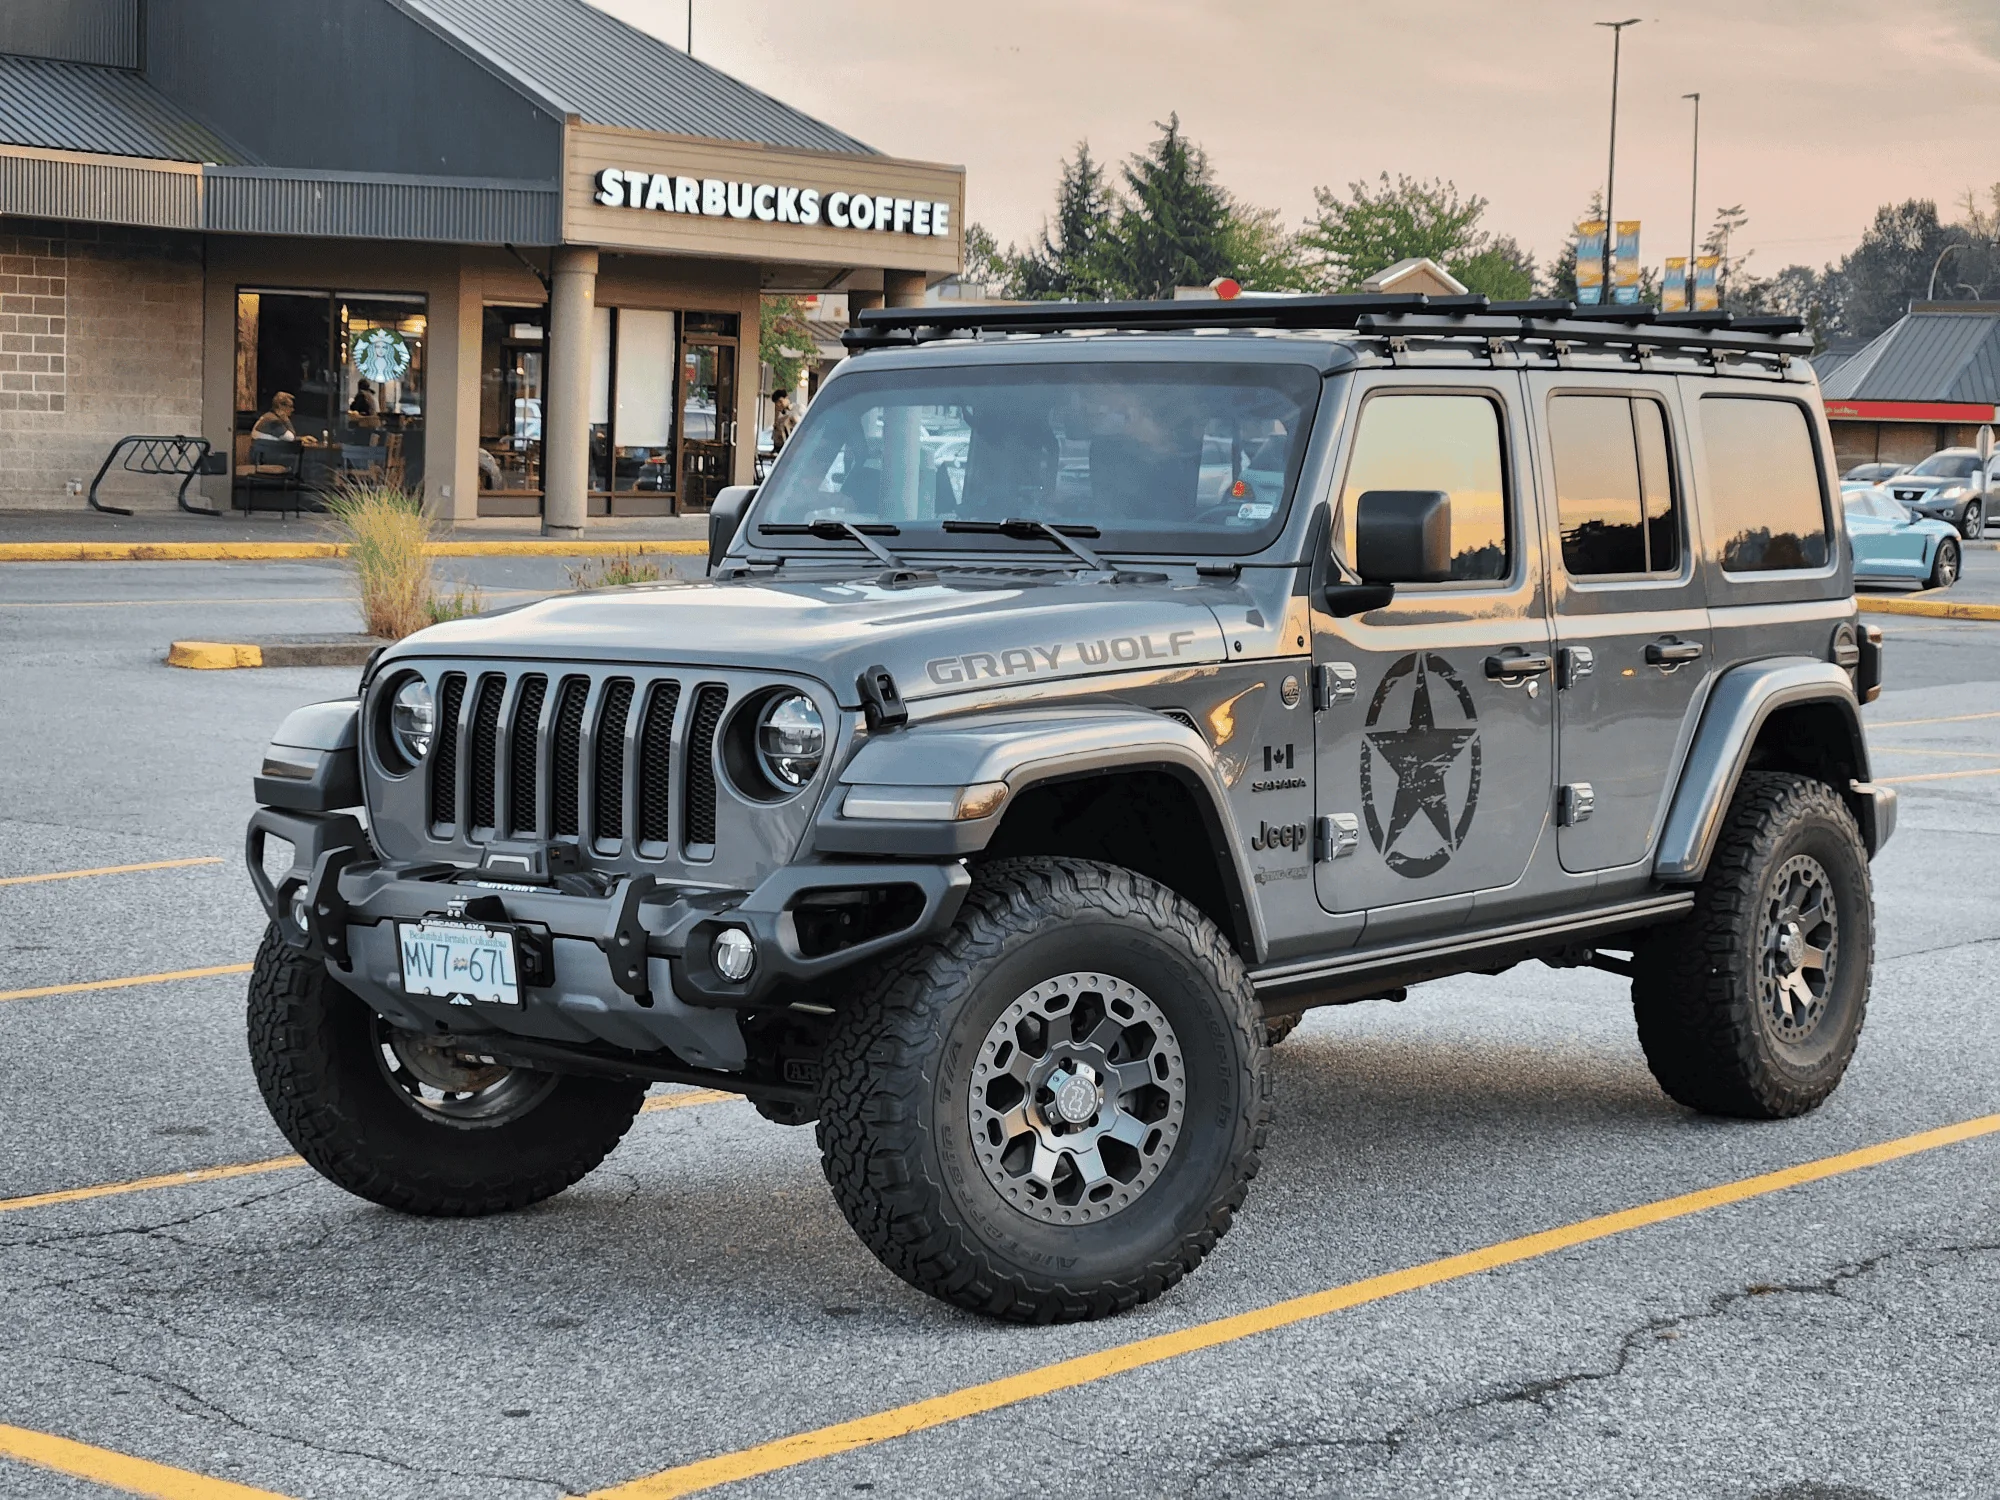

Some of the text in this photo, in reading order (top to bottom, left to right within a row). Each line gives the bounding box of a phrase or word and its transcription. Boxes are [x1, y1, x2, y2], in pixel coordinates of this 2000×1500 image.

[597, 167, 949, 237] STARBUCKS COFFEE
[926, 630, 1195, 685] GRAY WOLF
[1251, 776, 1307, 793] SAHARA
[1251, 819, 1307, 852] Jeep
[404, 941, 517, 987] MV7 67L
